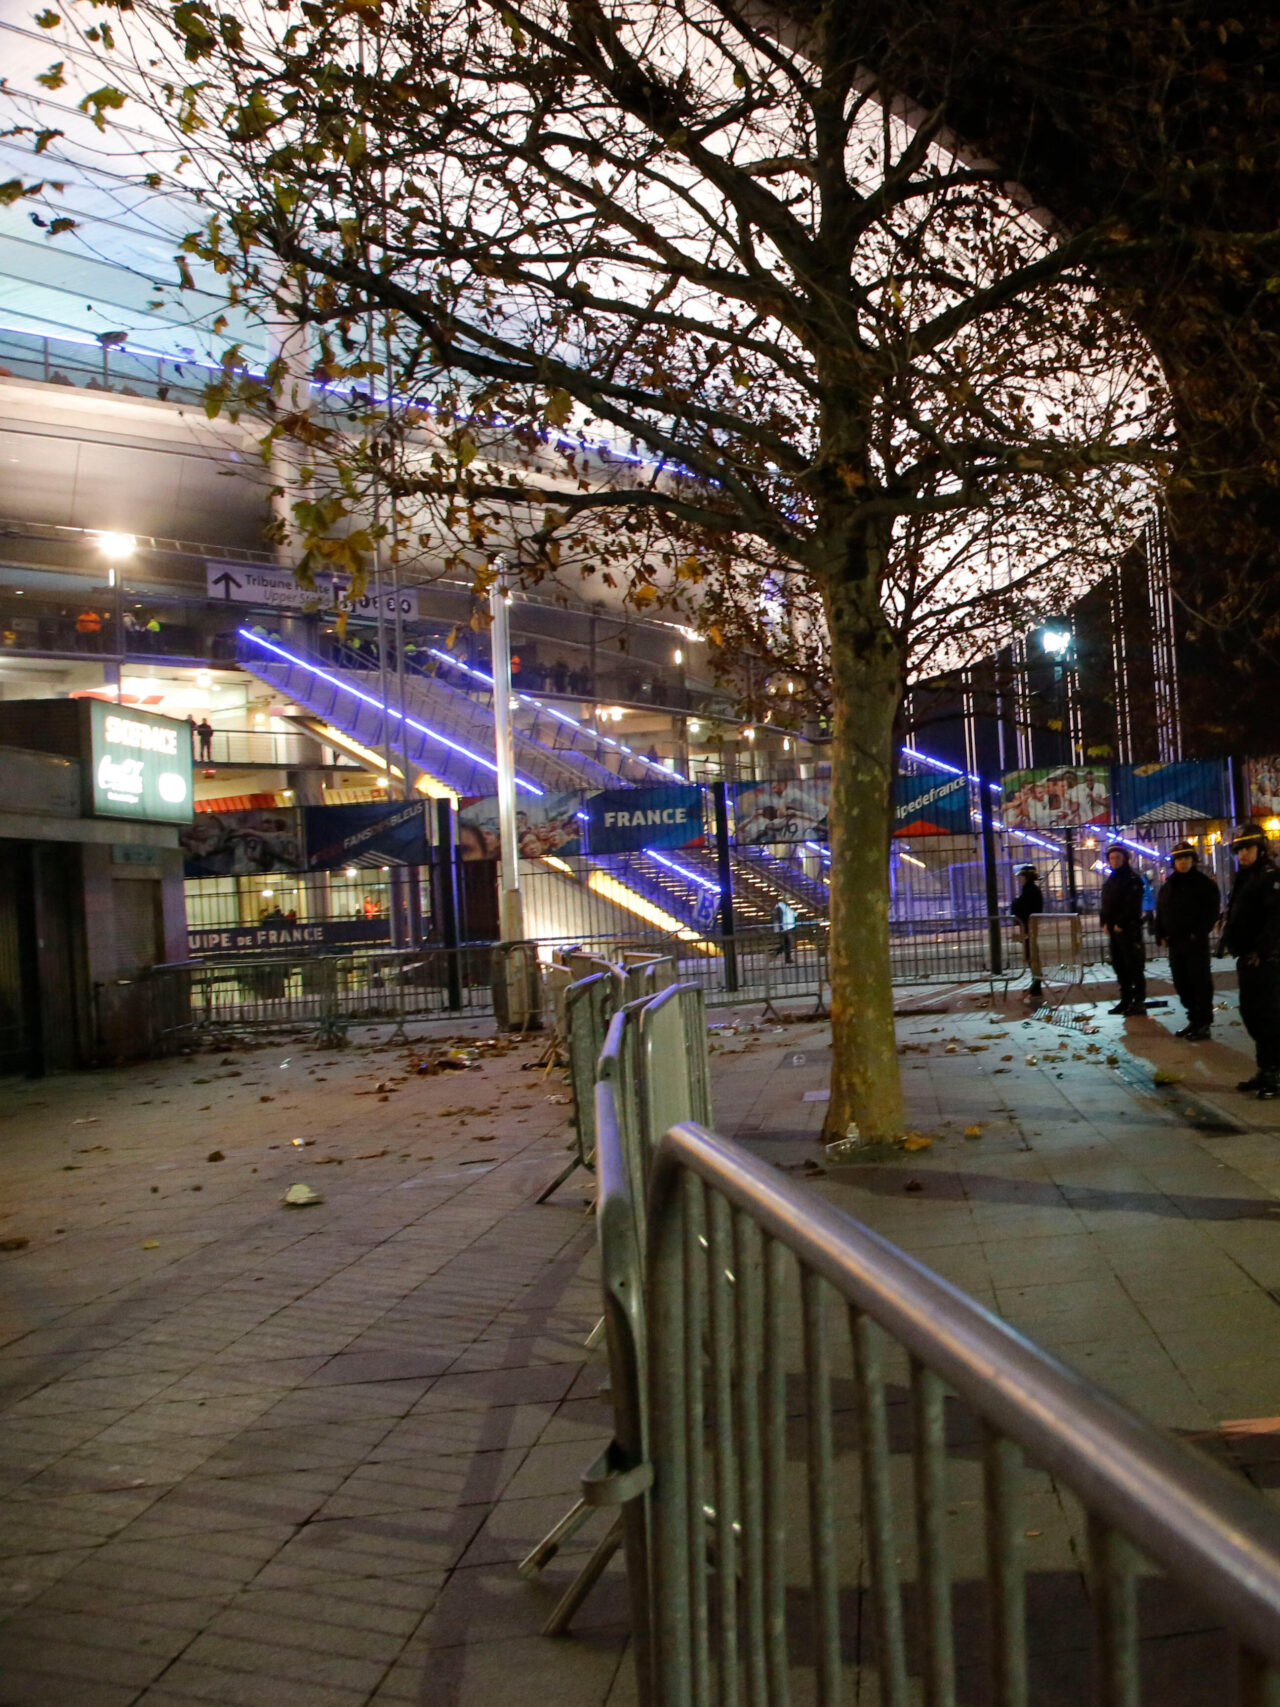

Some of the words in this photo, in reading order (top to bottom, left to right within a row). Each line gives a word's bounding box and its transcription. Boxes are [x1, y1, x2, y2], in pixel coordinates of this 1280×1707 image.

[244, 574, 292, 591] Tribune
[299, 593, 330, 606] Std
[896, 775, 967, 819] ipedefrance
[604, 807, 687, 828] FRANCE
[188, 932, 232, 949] UIPE
[237, 935, 253, 946] DE
[257, 926, 324, 946] FRANCE
